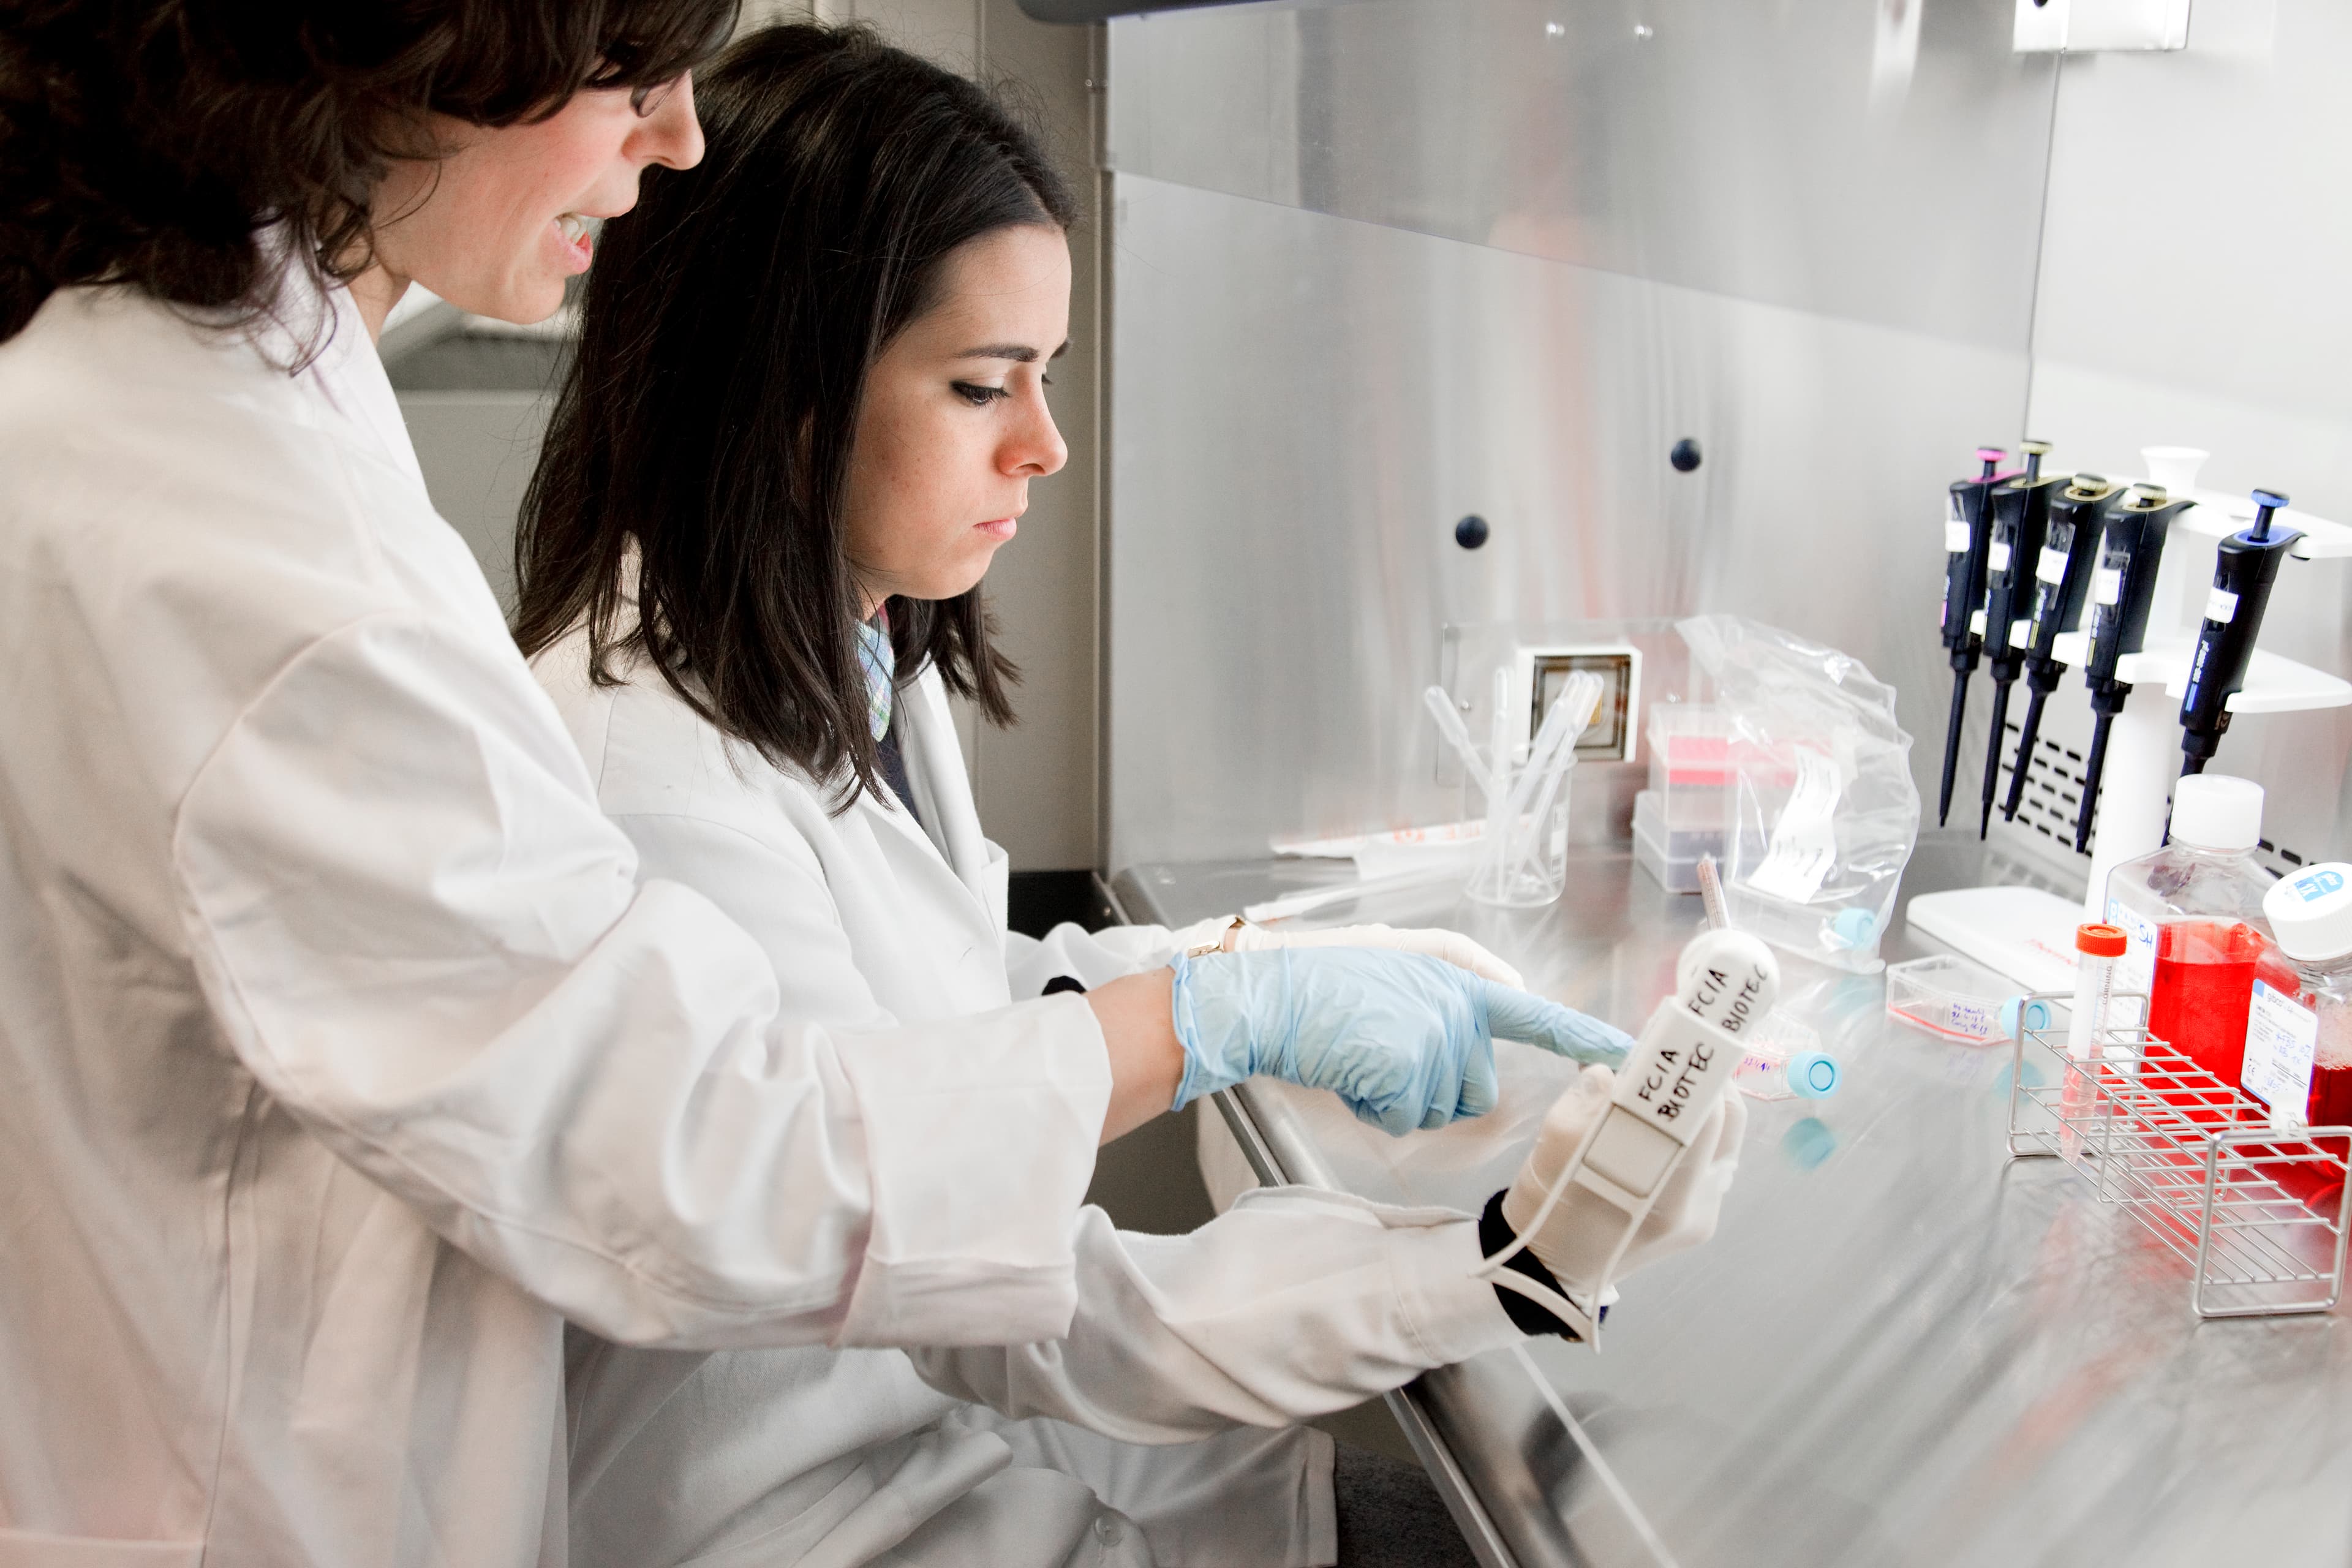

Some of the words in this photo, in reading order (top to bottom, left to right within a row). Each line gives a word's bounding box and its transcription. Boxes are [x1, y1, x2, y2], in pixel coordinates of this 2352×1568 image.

[1689, 968, 1729, 1017] FCIA
[1722, 964, 1768, 1032] BIOTEC
[2103, 966, 2113, 1005] CORNING
[1638, 1048, 1680, 1101] FCIA
[1657, 1043, 1714, 1121] BIOTEC
